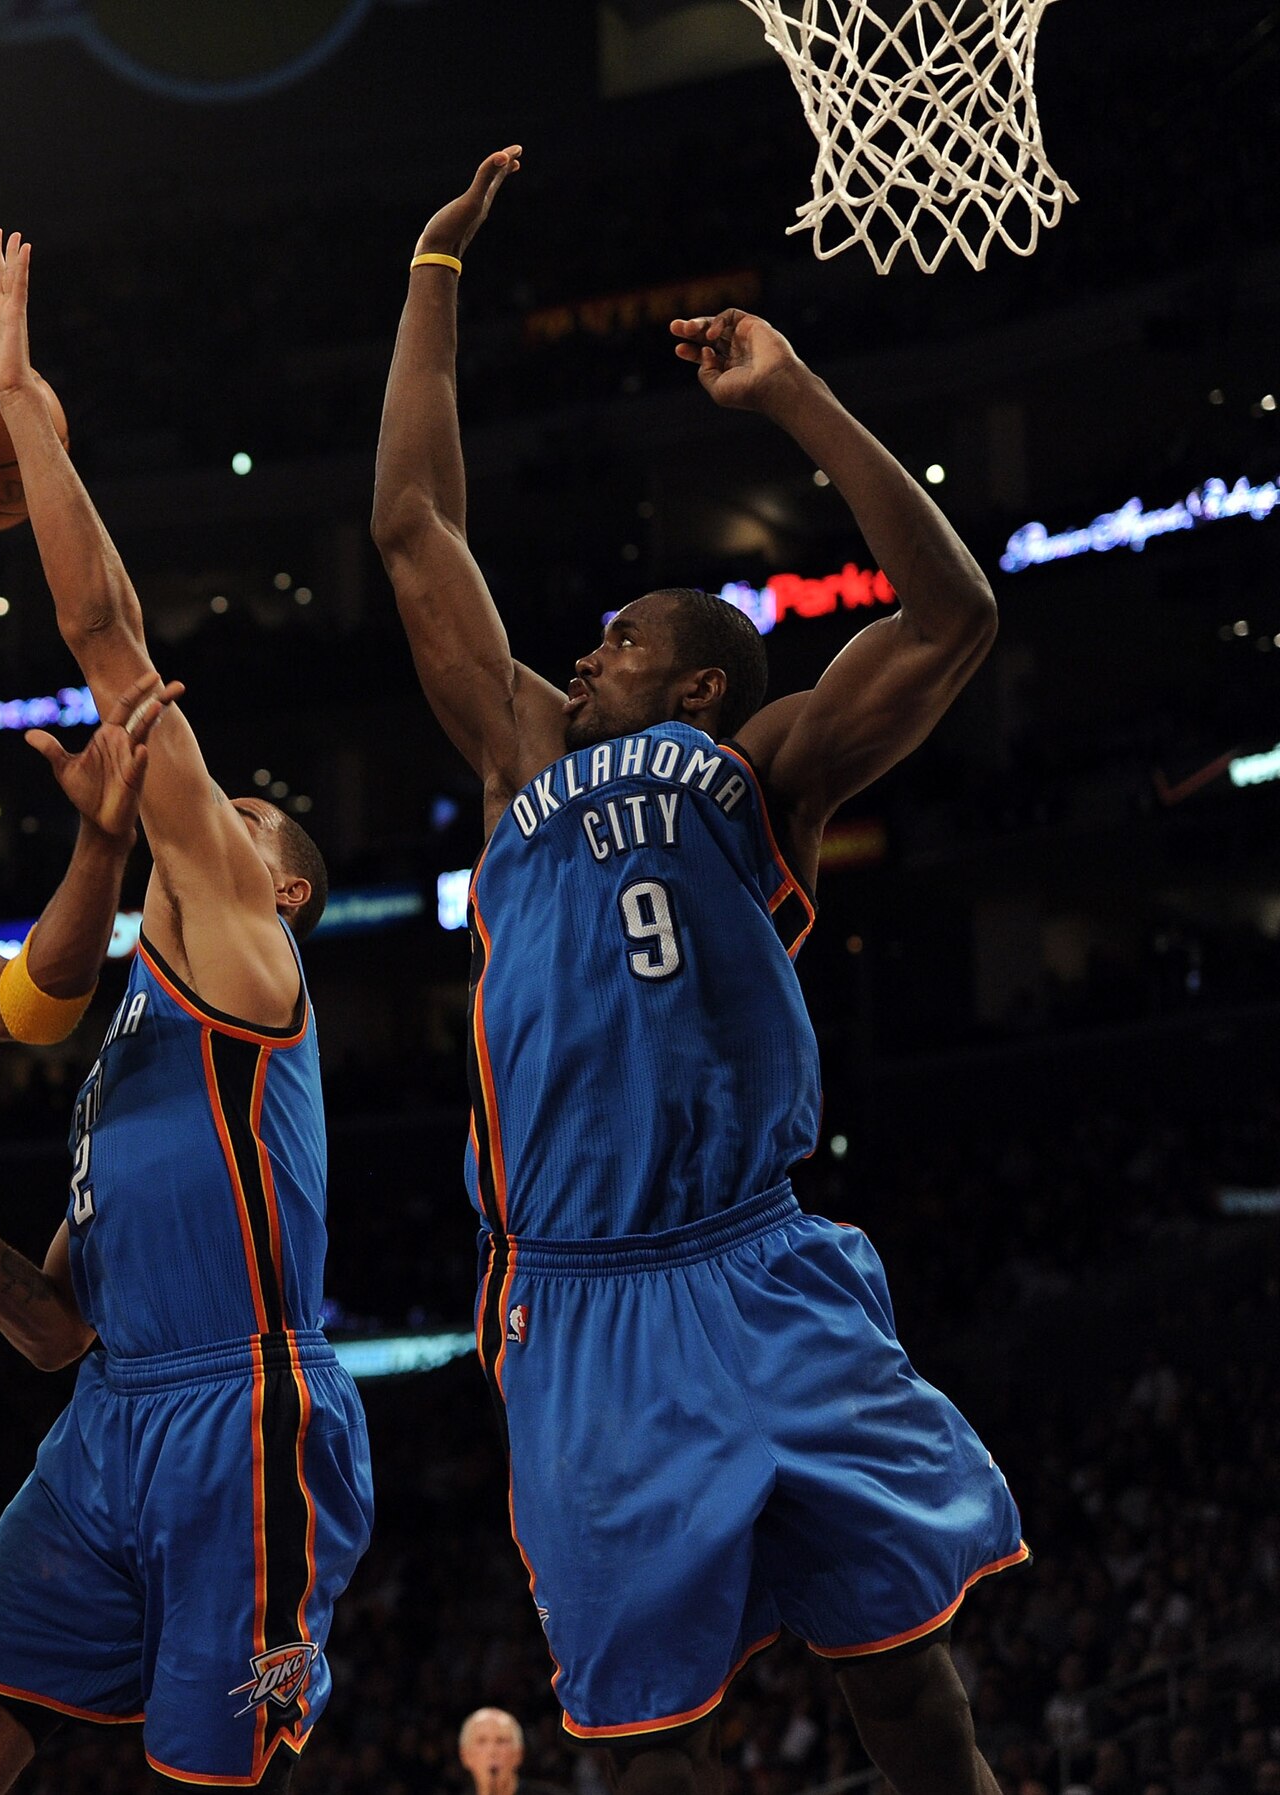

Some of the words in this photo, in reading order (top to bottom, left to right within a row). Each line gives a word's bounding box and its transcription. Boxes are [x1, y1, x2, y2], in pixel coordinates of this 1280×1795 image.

[511, 736, 748, 838] OKLAHOMA
[581, 792, 679, 861] CITY
[619, 878, 683, 982] 9
[252, 1652, 304, 1700] OKC
